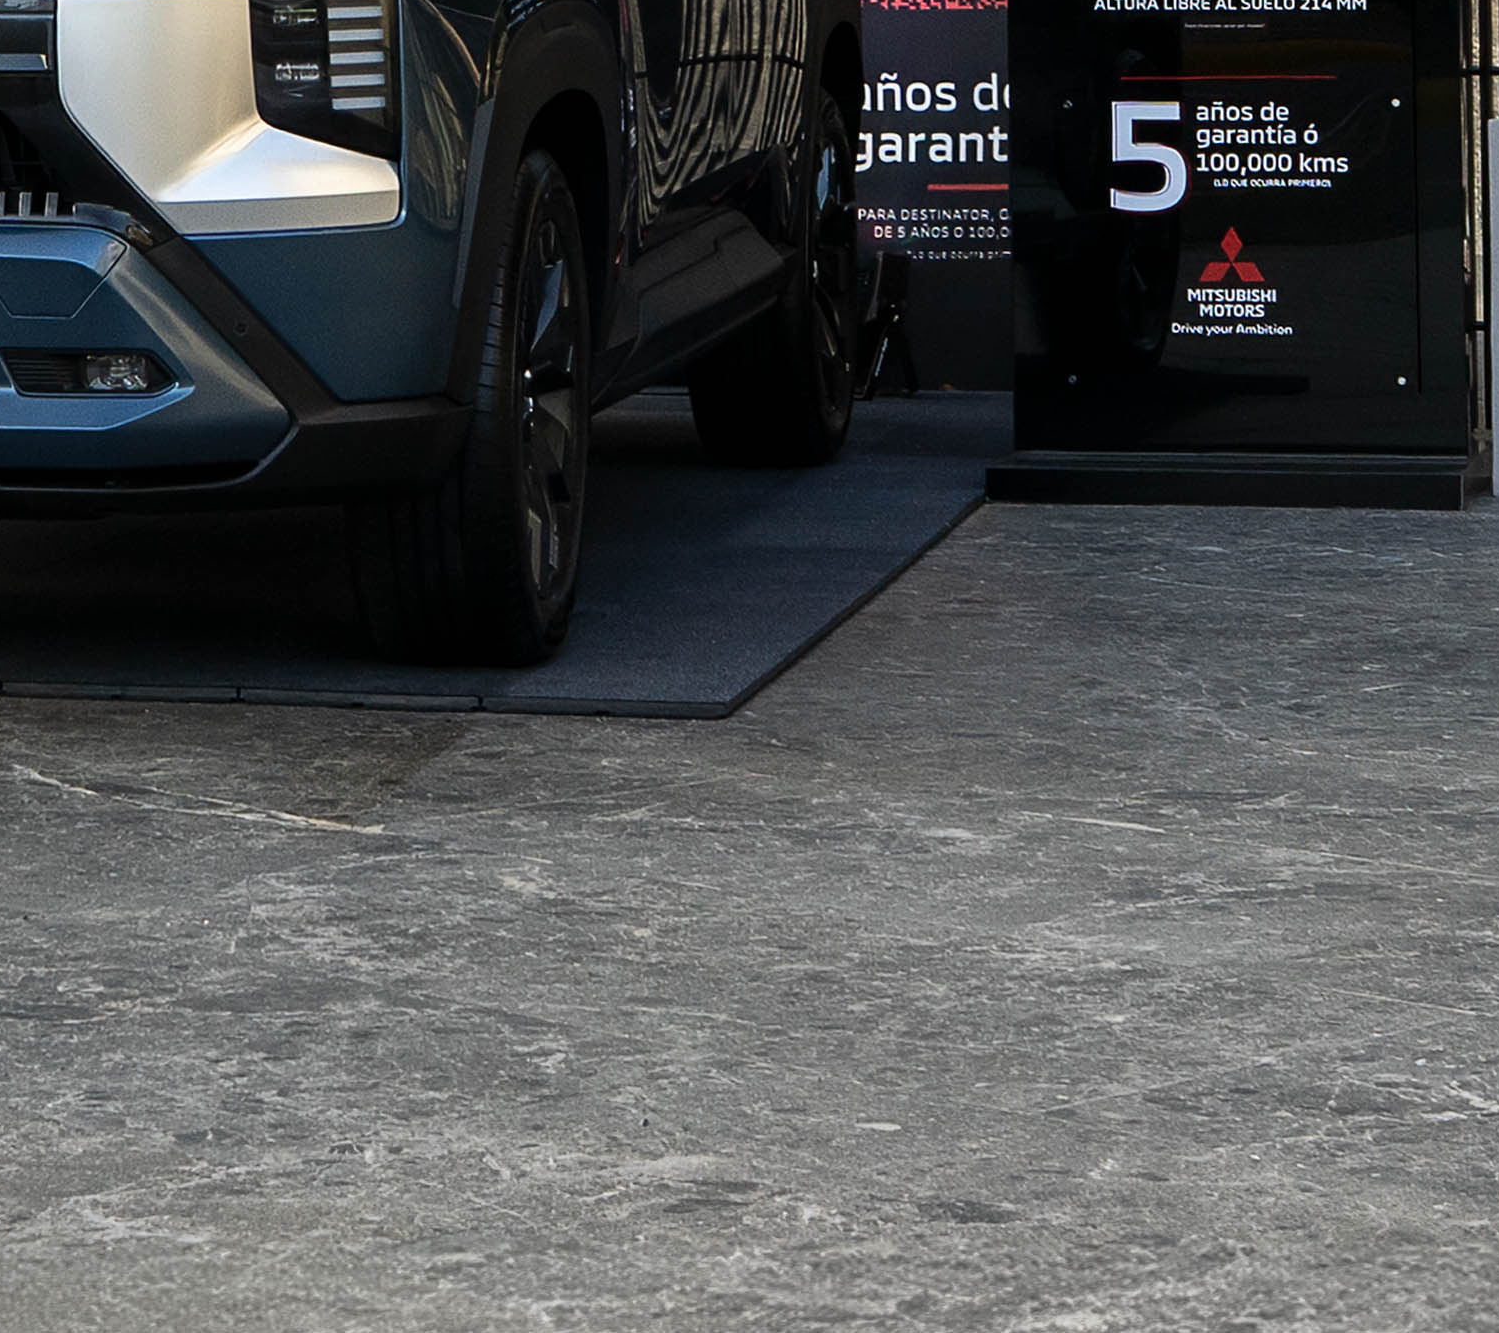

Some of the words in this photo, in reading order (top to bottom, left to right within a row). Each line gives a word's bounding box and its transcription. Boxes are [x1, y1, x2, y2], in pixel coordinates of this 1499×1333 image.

[973, 72, 1010, 111] d
[1196, 101, 1254, 122] años
[1260, 101, 1290, 121] de
[1196, 123, 1297, 149] garantía
[1303, 123, 1319, 145] ó
[854, 125, 1009, 173] garant
[1110, 101, 1187, 212] 5
[1196, 152, 1293, 177] 100,000
[1299, 152, 1349, 173] kms
[857, 207, 897, 221] PARA
[900, 208, 994, 223] DESTINATOR,
[873, 225, 893, 239] DE
[910, 222, 950, 239] AÑOS
[953, 226, 964, 239] O
[969, 225, 1010, 239] 100,0
[1187, 288, 1277, 303] MITSUBISHI
[1199, 303, 1265, 318] MOTORS
[1171, 322, 1204, 335] Drive
[1205, 325, 1234, 337] your
[1235, 323, 1293, 336] Ambition
